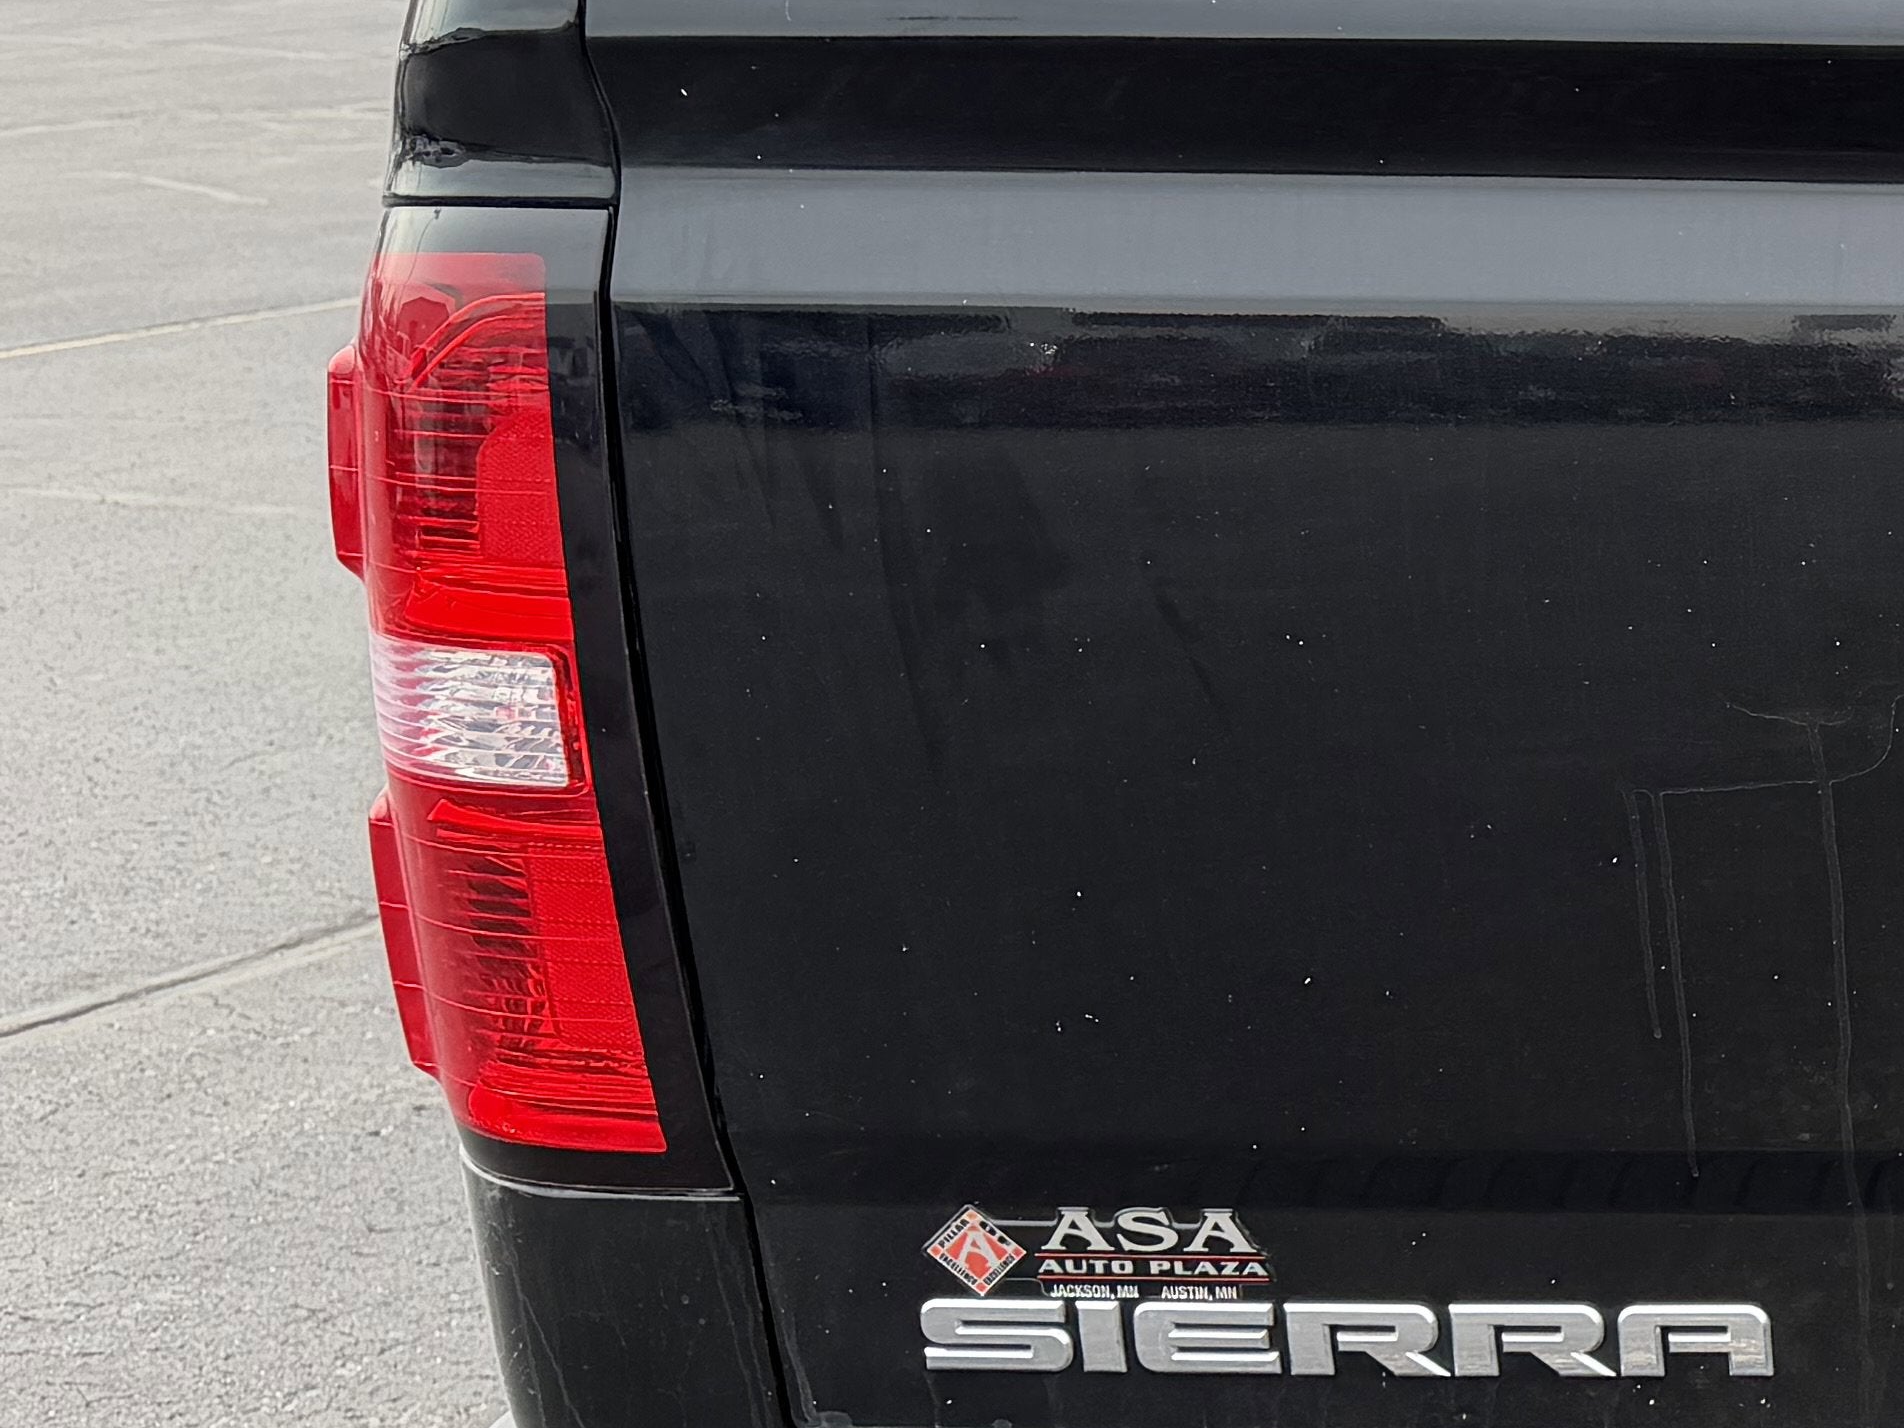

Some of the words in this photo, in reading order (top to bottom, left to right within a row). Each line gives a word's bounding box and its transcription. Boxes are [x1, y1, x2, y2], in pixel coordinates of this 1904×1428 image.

[1041, 1210, 1258, 1253] ASA
[1038, 1259, 1134, 1275] AUTO
[1149, 1260, 1269, 1277] PLAZA
[1050, 1284, 1116, 1300] JACKSON,
[1116, 1285, 1139, 1299] MN
[1161, 1285, 1213, 1301] AUSTIN,
[1215, 1286, 1238, 1300] MN
[919, 1297, 1774, 1376] SIERRA
